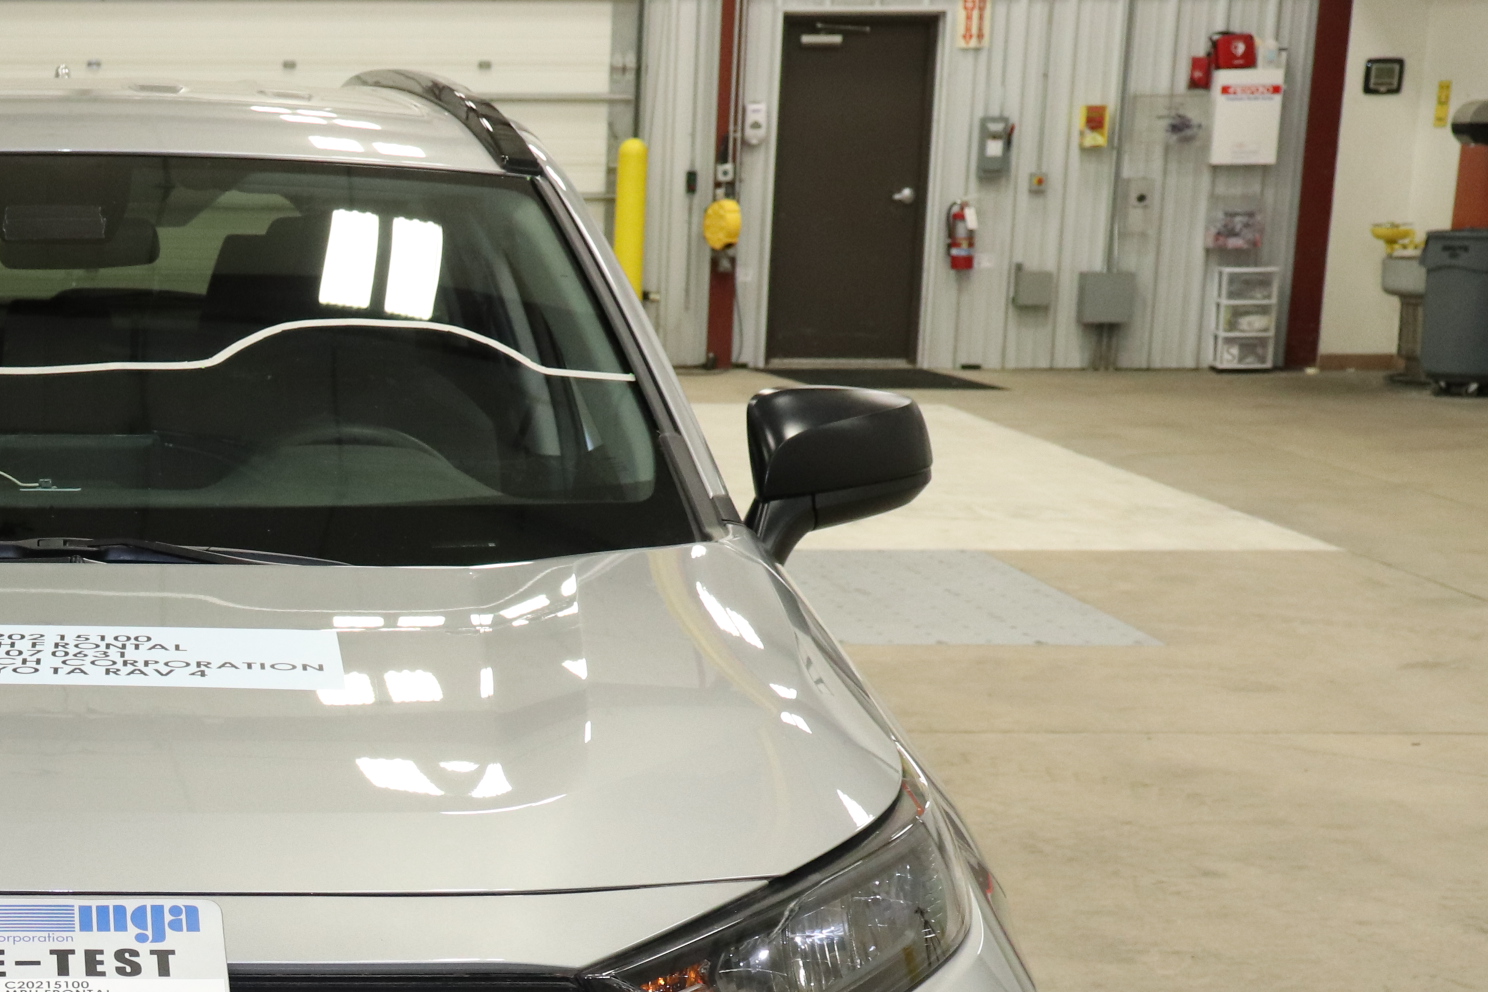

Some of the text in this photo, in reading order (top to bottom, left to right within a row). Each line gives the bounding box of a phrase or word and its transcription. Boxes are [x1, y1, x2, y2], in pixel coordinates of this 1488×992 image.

[30, 642, 187, 652] FRONTAL
[61, 658, 324, 671] CORPORATION
[104, 668, 175, 677] RAV
[188, 669, 208, 678] 4
[78, 904, 201, 943] mga
[5, 980, 89, 990] C20215100
